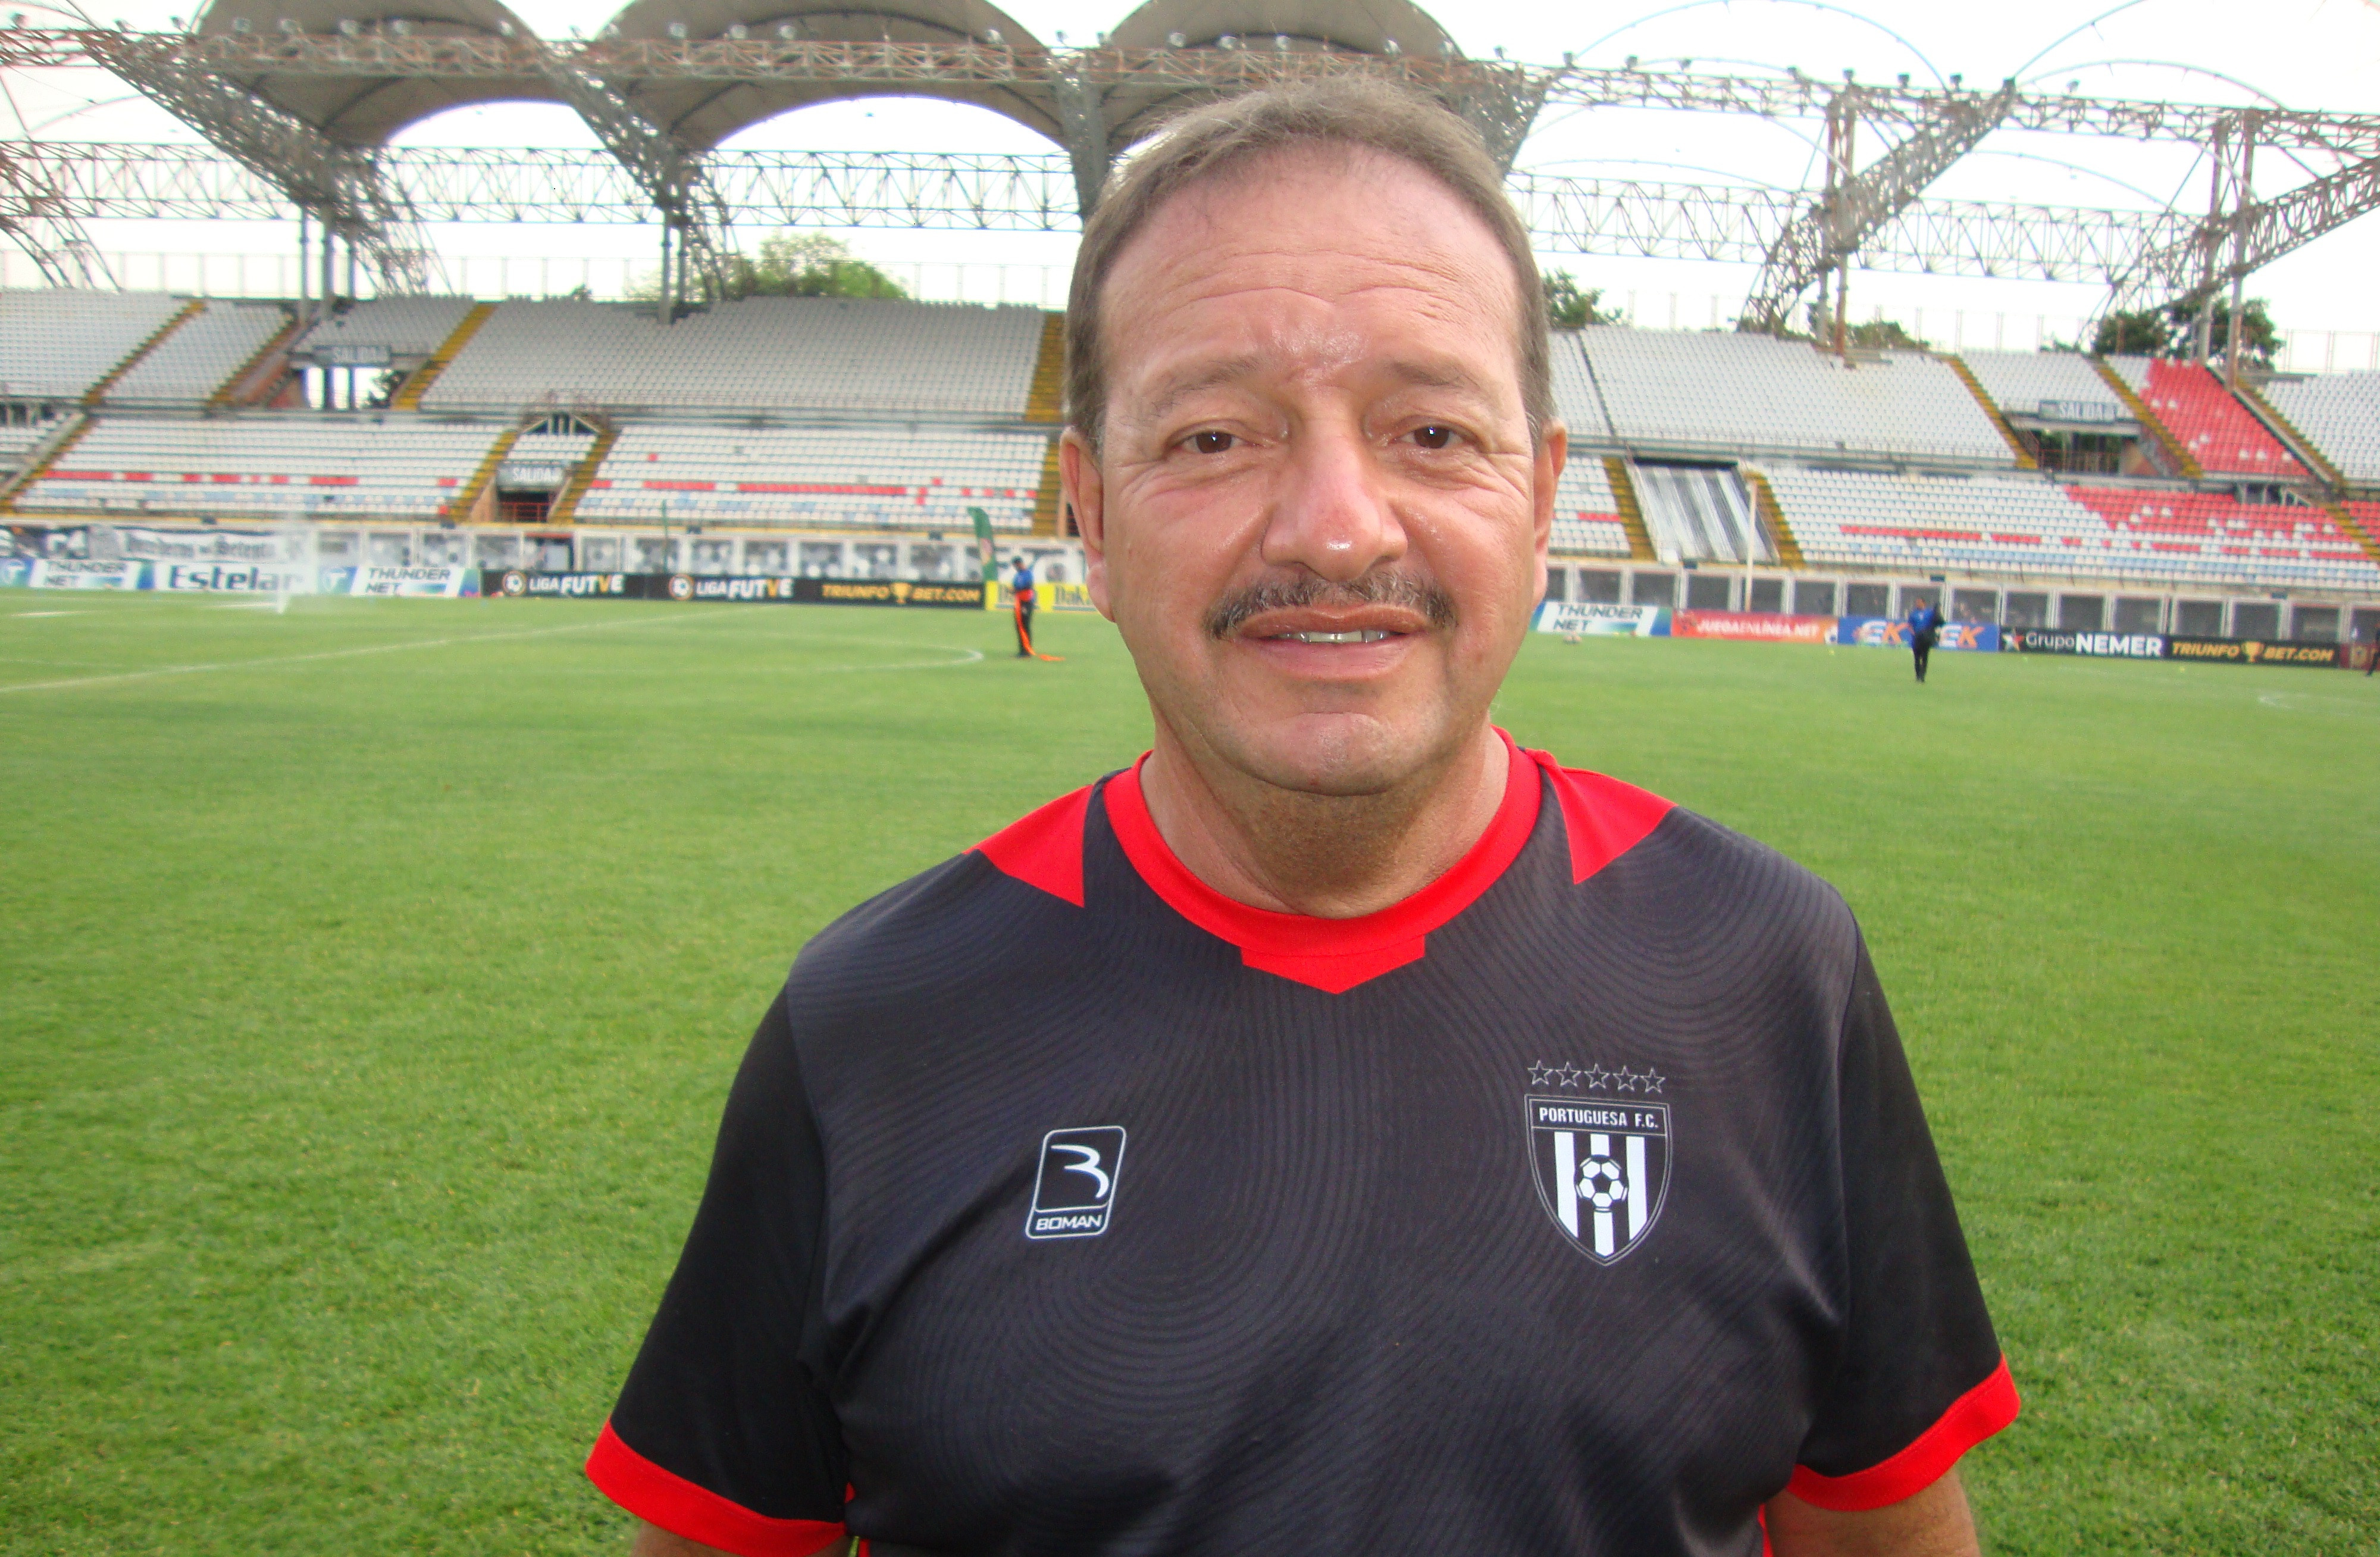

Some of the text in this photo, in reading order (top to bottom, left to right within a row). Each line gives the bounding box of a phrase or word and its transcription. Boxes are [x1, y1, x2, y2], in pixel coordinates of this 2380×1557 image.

[46, 561, 126, 573] THUNDER
[368, 567, 451, 580] THUNDER
[45, 574, 80, 586] NET
[168, 565, 304, 590] Estelar
[529, 574, 624, 595] LIGA FUTVE
[365, 581, 402, 593] NET
[696, 578, 792, 599] LIGA FUTVE
[822, 584, 889, 599] TRIUNFO
[912, 587, 981, 602] BET.COM
[1558, 604, 1643, 618] THUNDER
[1553, 619, 1591, 631] NET
[2025, 631, 2163, 657] Grupo NEMER
[2172, 642, 2240, 657] TRIUNFO
[2263, 646, 2334, 661] BET.COM
[1539, 1106, 1658, 1128] PORTUGUESA F.C.
[1036, 1214, 1103, 1230] BOMAN
